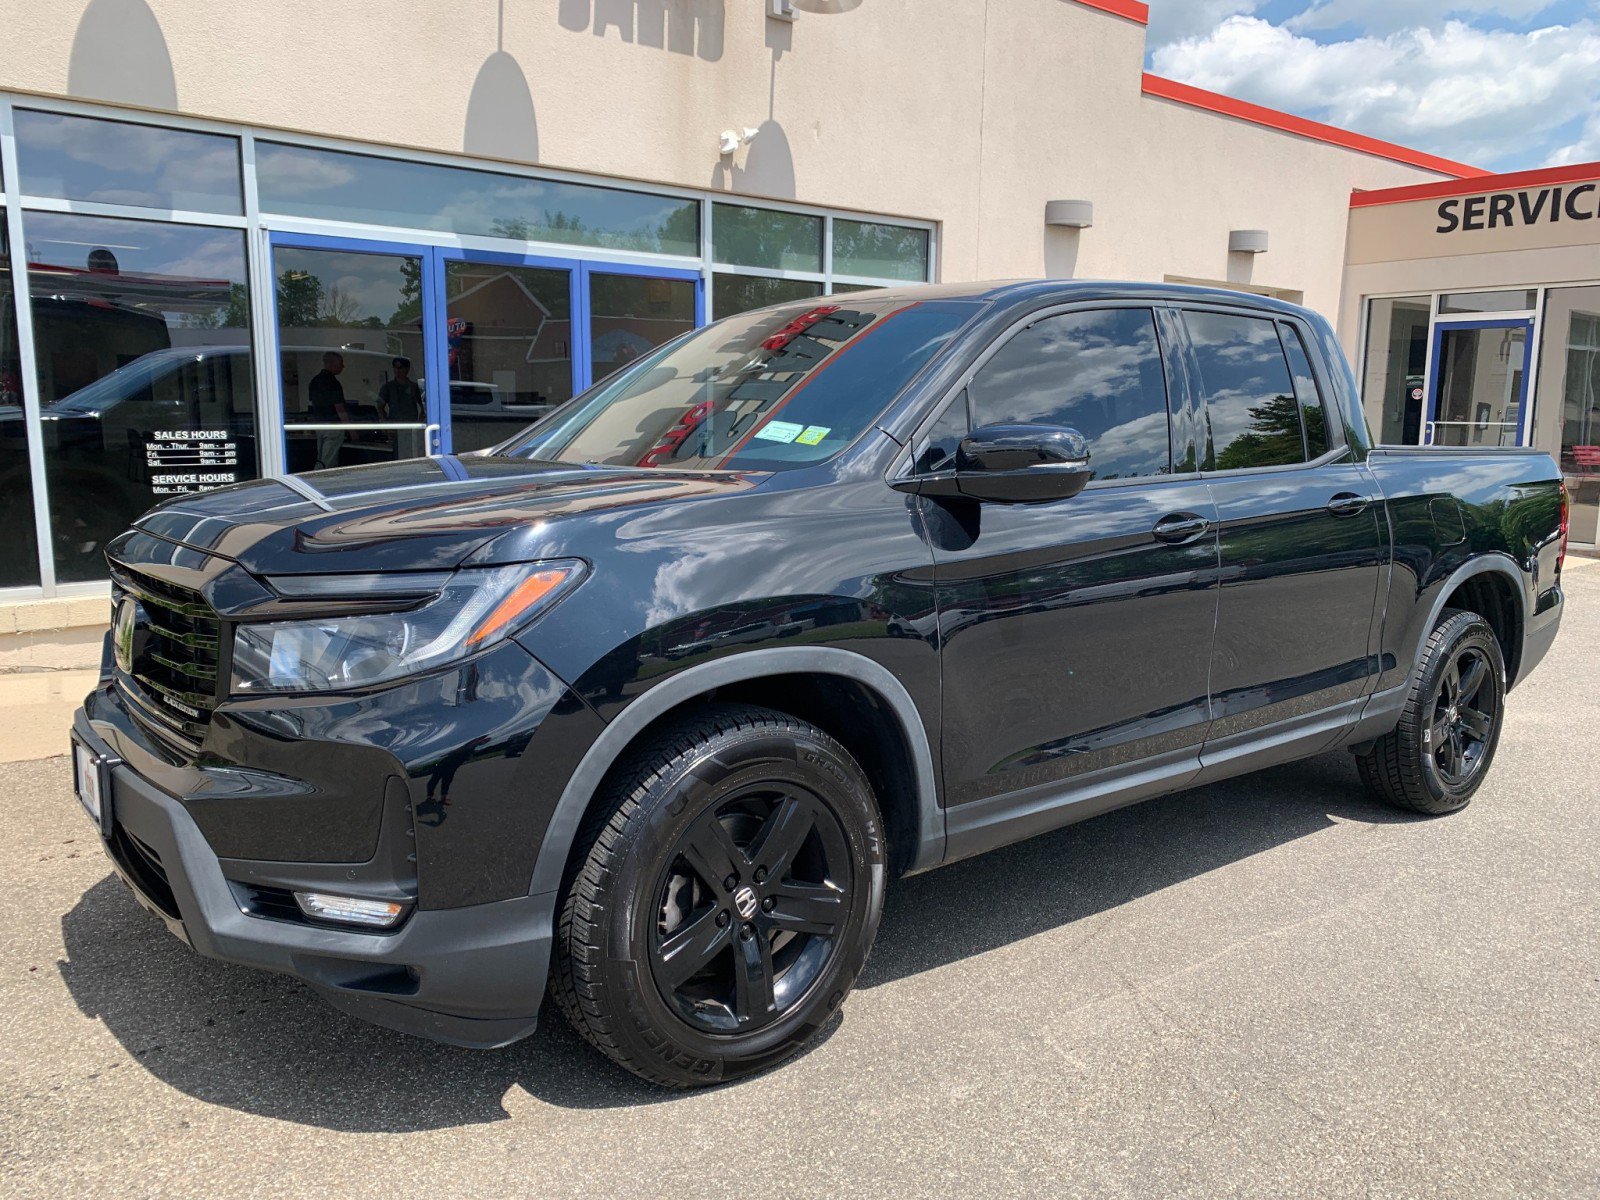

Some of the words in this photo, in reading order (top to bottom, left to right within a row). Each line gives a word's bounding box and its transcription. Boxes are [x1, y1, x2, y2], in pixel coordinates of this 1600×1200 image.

[1436, 184, 1600, 233] SERVIC
[154, 431, 189, 439] SALES
[191, 430, 227, 439] HOURS
[170, 442, 190, 450] Thur.
[152, 474, 197, 483] SERVICE
[199, 473, 235, 482] HOURS
